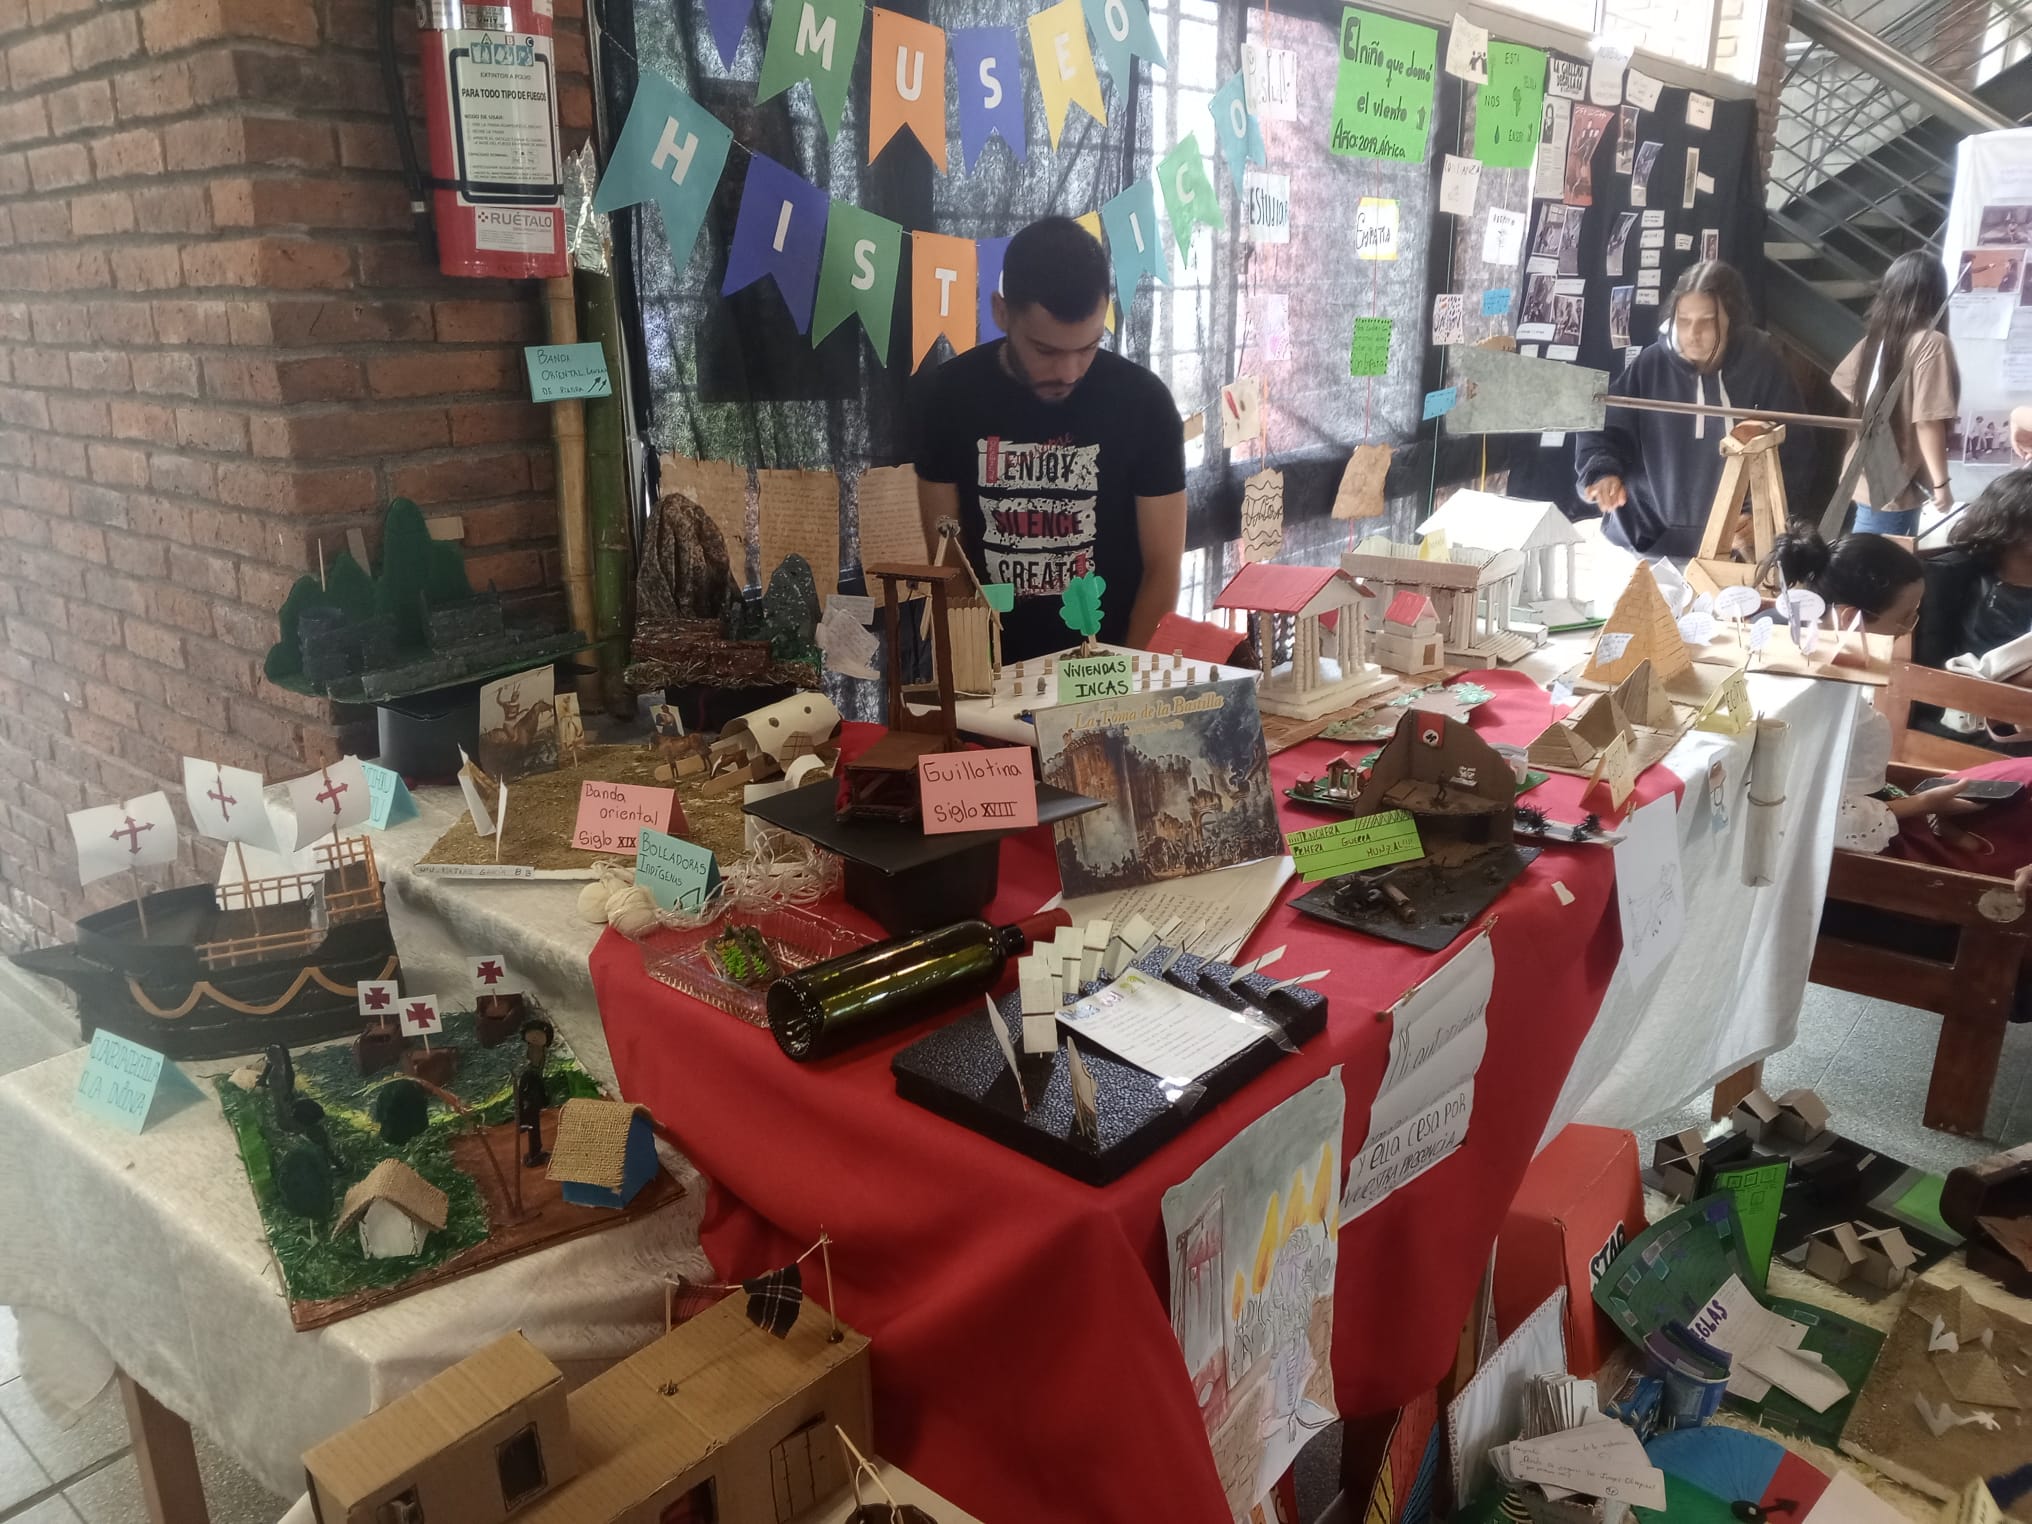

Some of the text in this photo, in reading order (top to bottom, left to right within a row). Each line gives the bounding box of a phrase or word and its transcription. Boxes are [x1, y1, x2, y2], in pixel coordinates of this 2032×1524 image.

[1360, 40, 1384, 68] niño
[1386, 58, 1404, 88] que
[461, 87, 546, 102] PARA TODO TIPO DE FUEGOS
[1357, 91, 1370, 115] el
[491, 211, 552, 229] RUÉTALO
[1004, 449, 1078, 483] ENJOY
[991, 507, 1084, 540] SILENCE
[1074, 679, 1129, 698] INCAS
[1074, 711, 1096, 729] La
[1100, 708, 1137, 727] Toma
[1141, 703, 1153, 719] de
[1157, 701, 1170, 717] la
[923, 758, 1022, 782] Guillotina
[585, 783, 626, 803] Banda
[599, 805, 658, 826] oriental
[980, 801, 1018, 818] XVIII
[578, 830, 637, 849] Siglo XIX
[642, 831, 707, 876] BOLEADORAS
